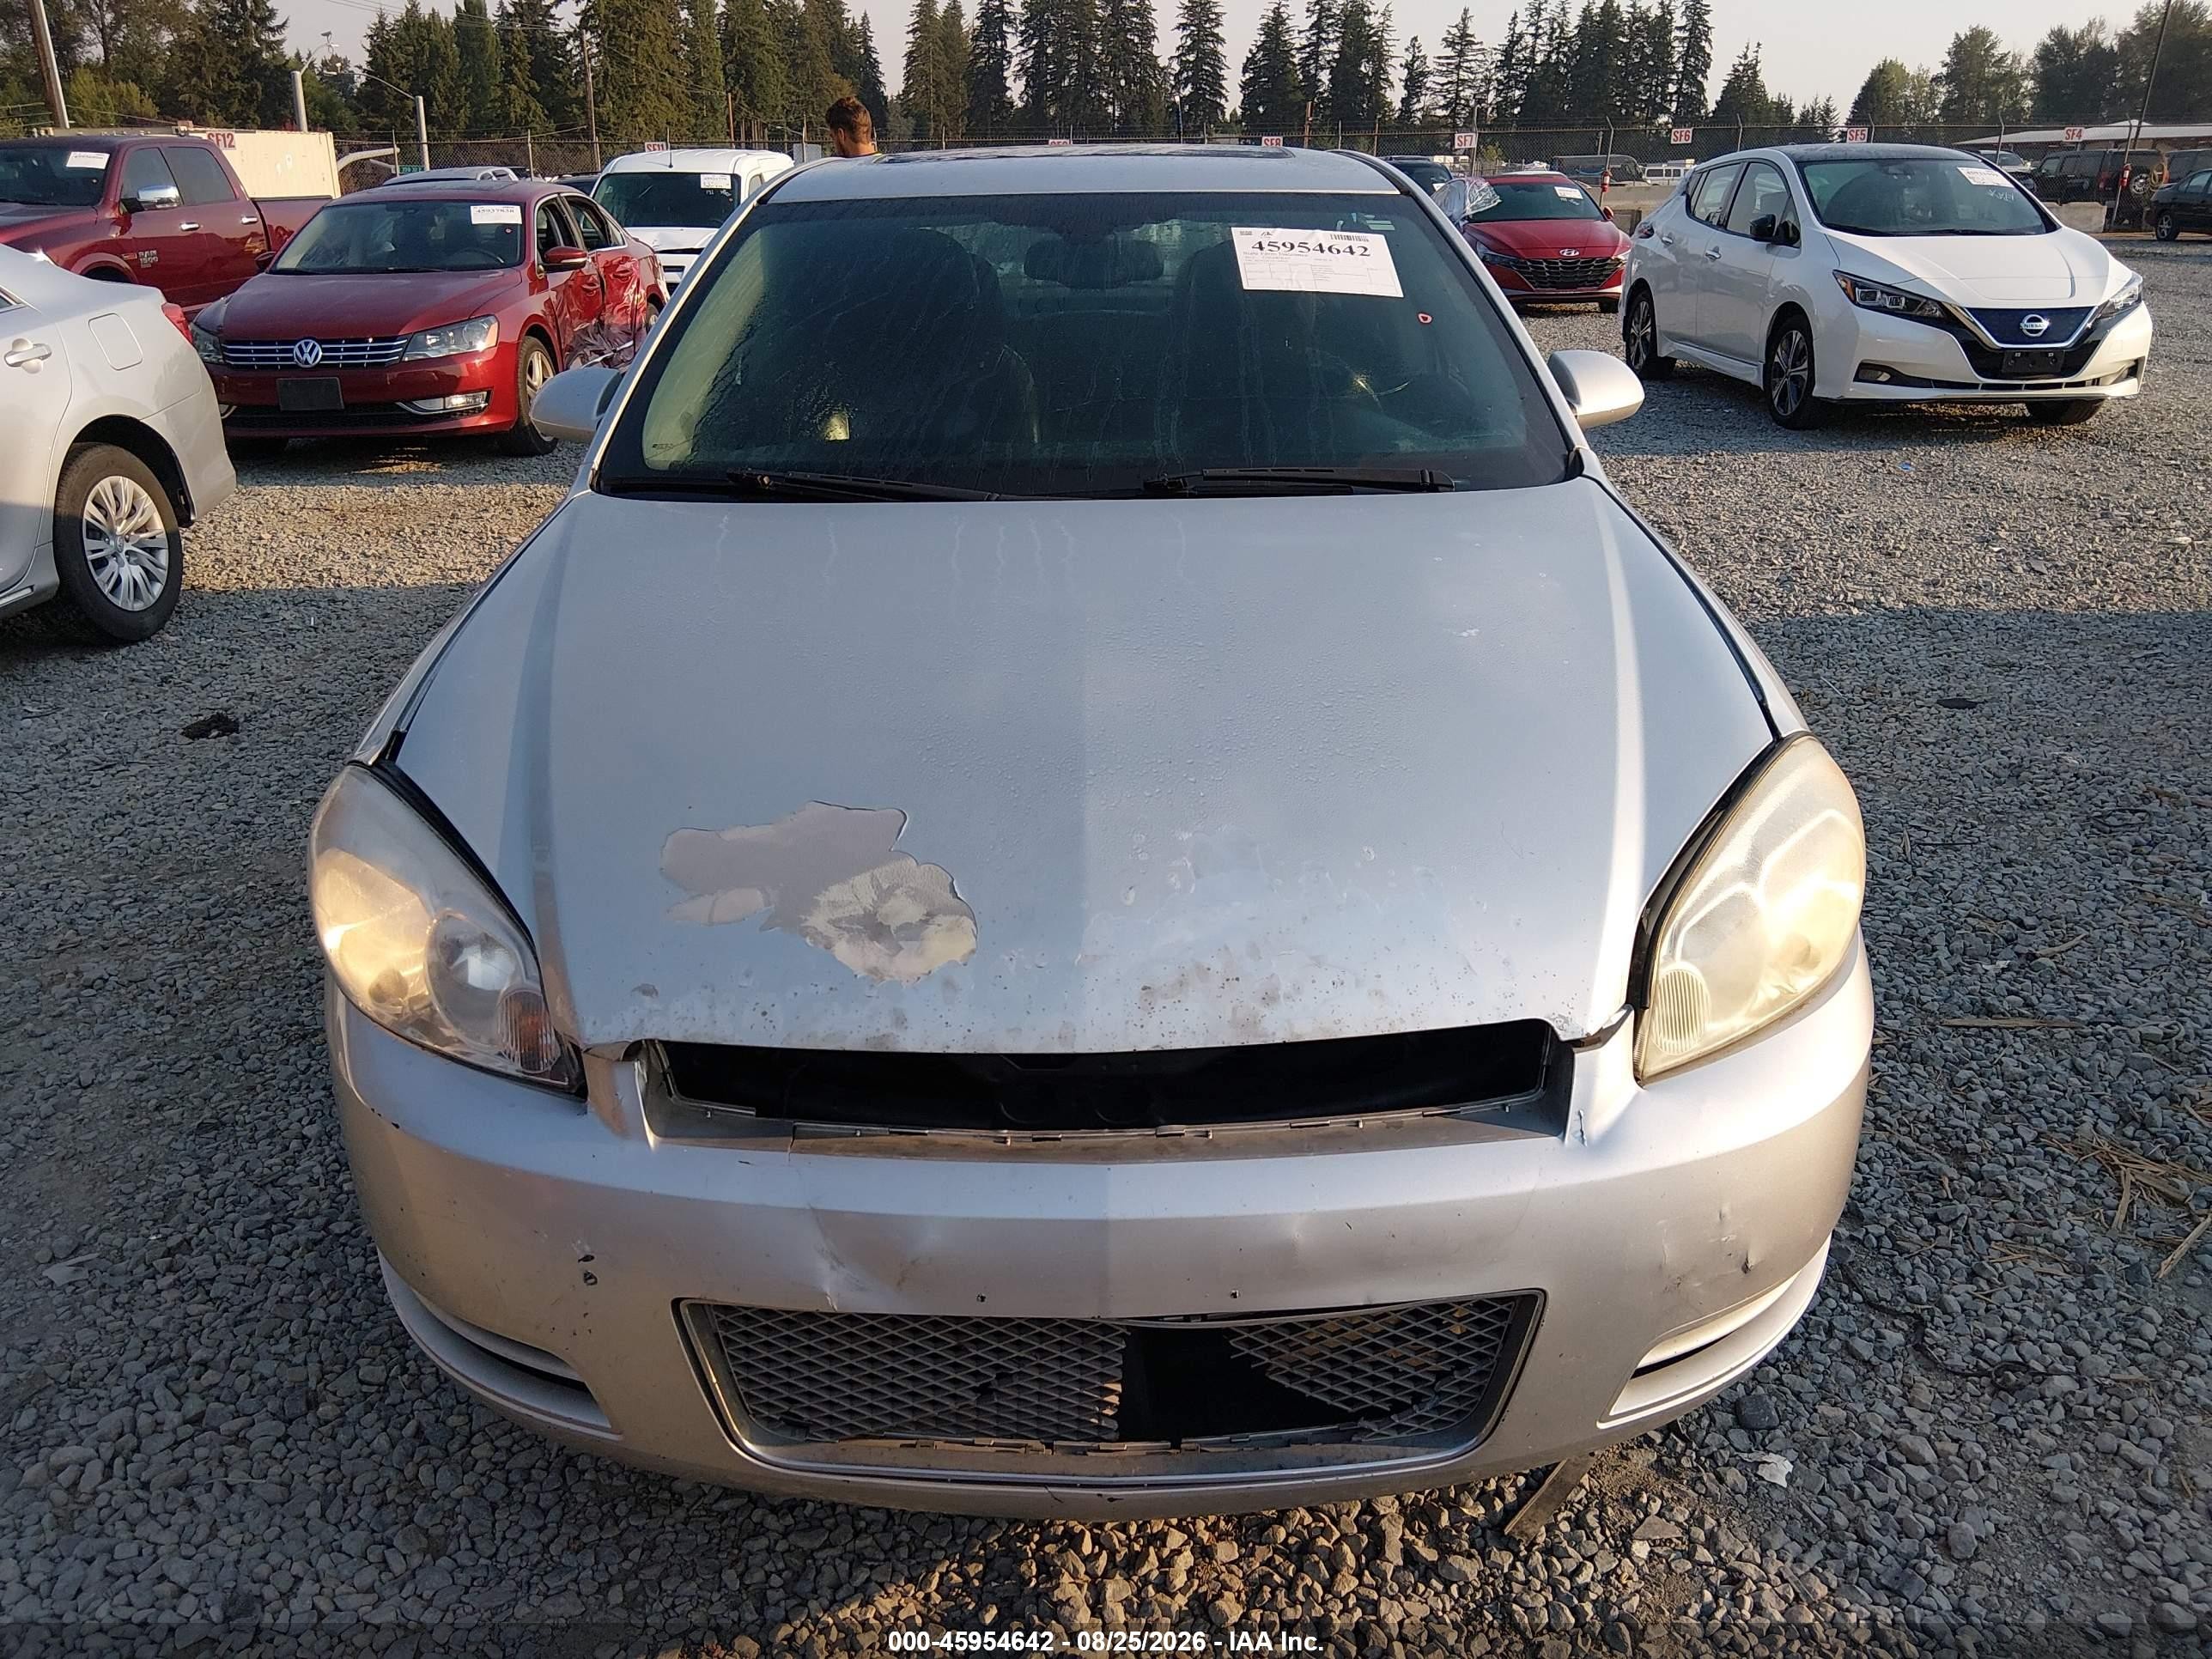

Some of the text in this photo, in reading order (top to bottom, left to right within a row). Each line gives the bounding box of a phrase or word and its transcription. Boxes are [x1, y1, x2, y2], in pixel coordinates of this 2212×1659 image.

[207, 132, 235, 148] SF12
[1673, 130, 1691, 142] SF6
[1848, 129, 1866, 141] SF5
[2065, 129, 2082, 140] SF4
[1457, 135, 1474, 147] SF7
[1251, 240, 1371, 257] 45954642
